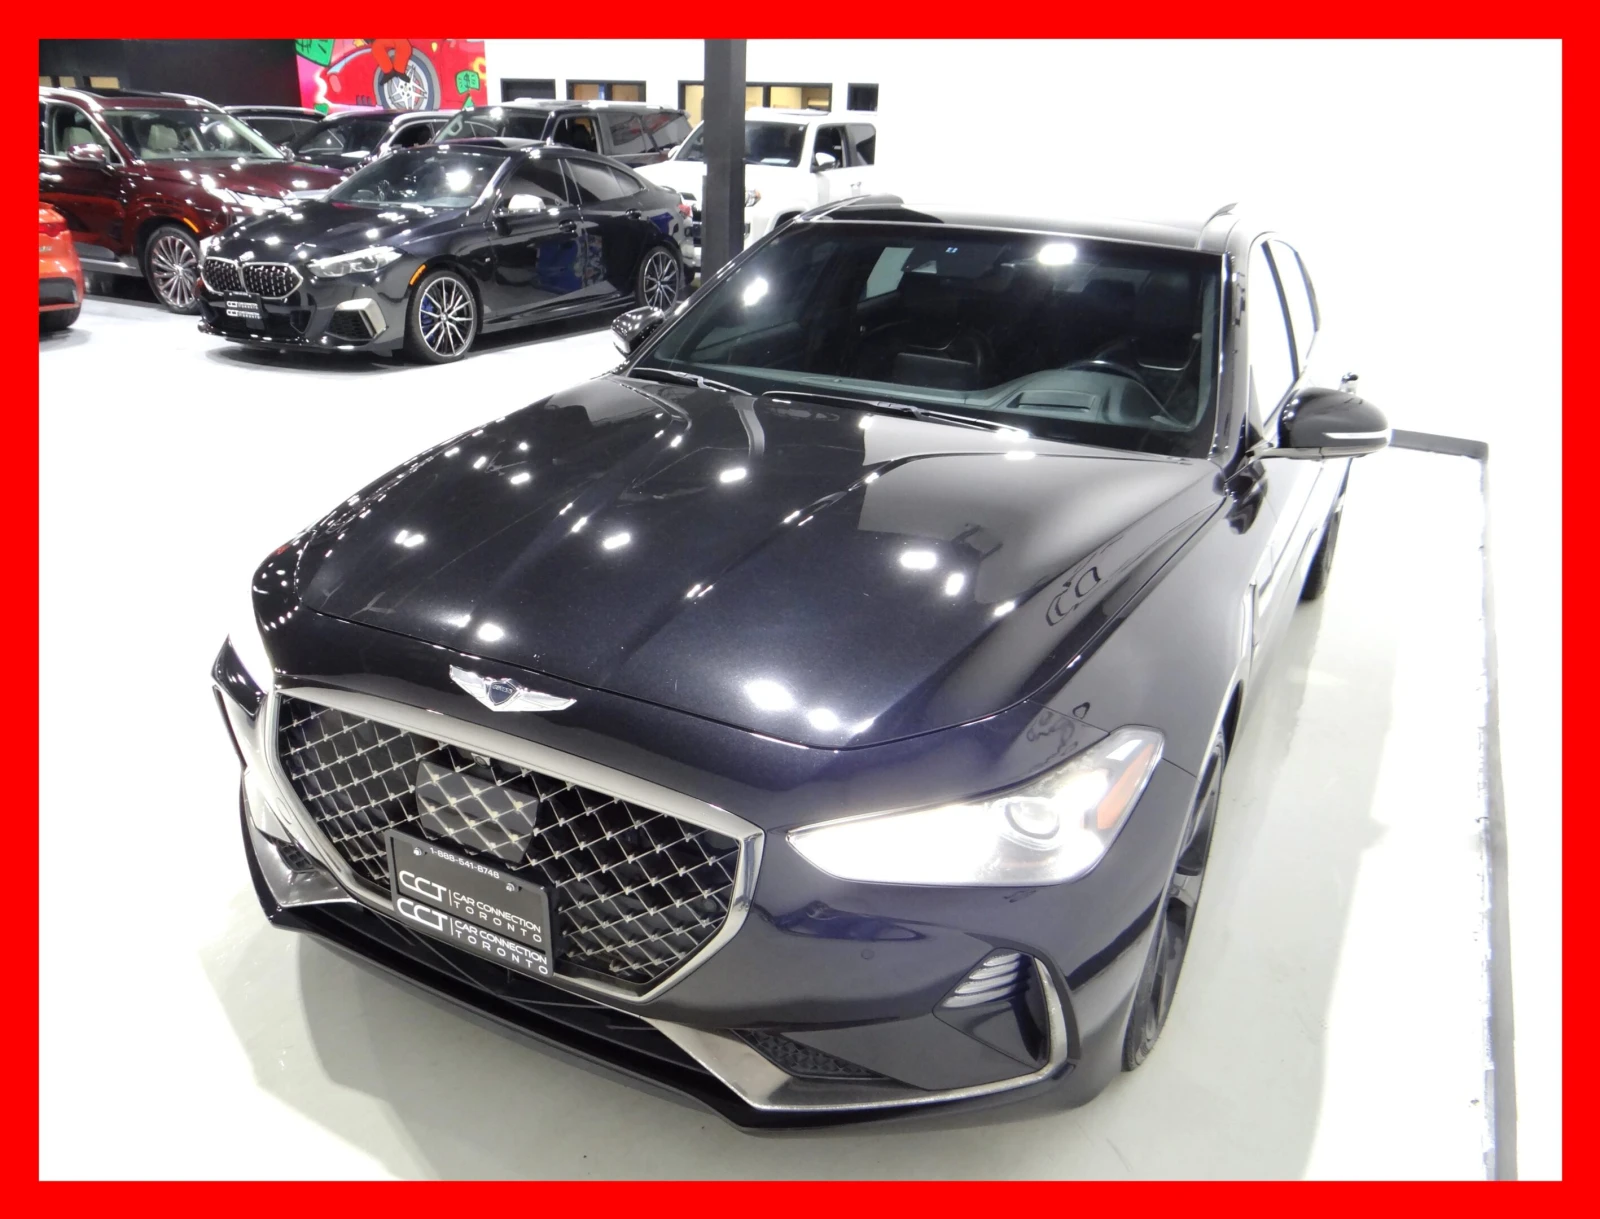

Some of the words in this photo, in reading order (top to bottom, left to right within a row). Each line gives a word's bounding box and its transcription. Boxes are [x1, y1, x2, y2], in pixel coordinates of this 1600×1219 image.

[430, 847, 500, 879] 1-888-541-8748
[399, 870, 447, 902] CCT
[397, 898, 449, 932] CCT
[453, 891, 475, 907] CAR
[476, 901, 541, 933] CONNECTION
[453, 902, 542, 943] TORONTO
[455, 920, 478, 936] CAR
[479, 930, 548, 965] CONNECTION
[455, 930, 549, 975] TORONTO
